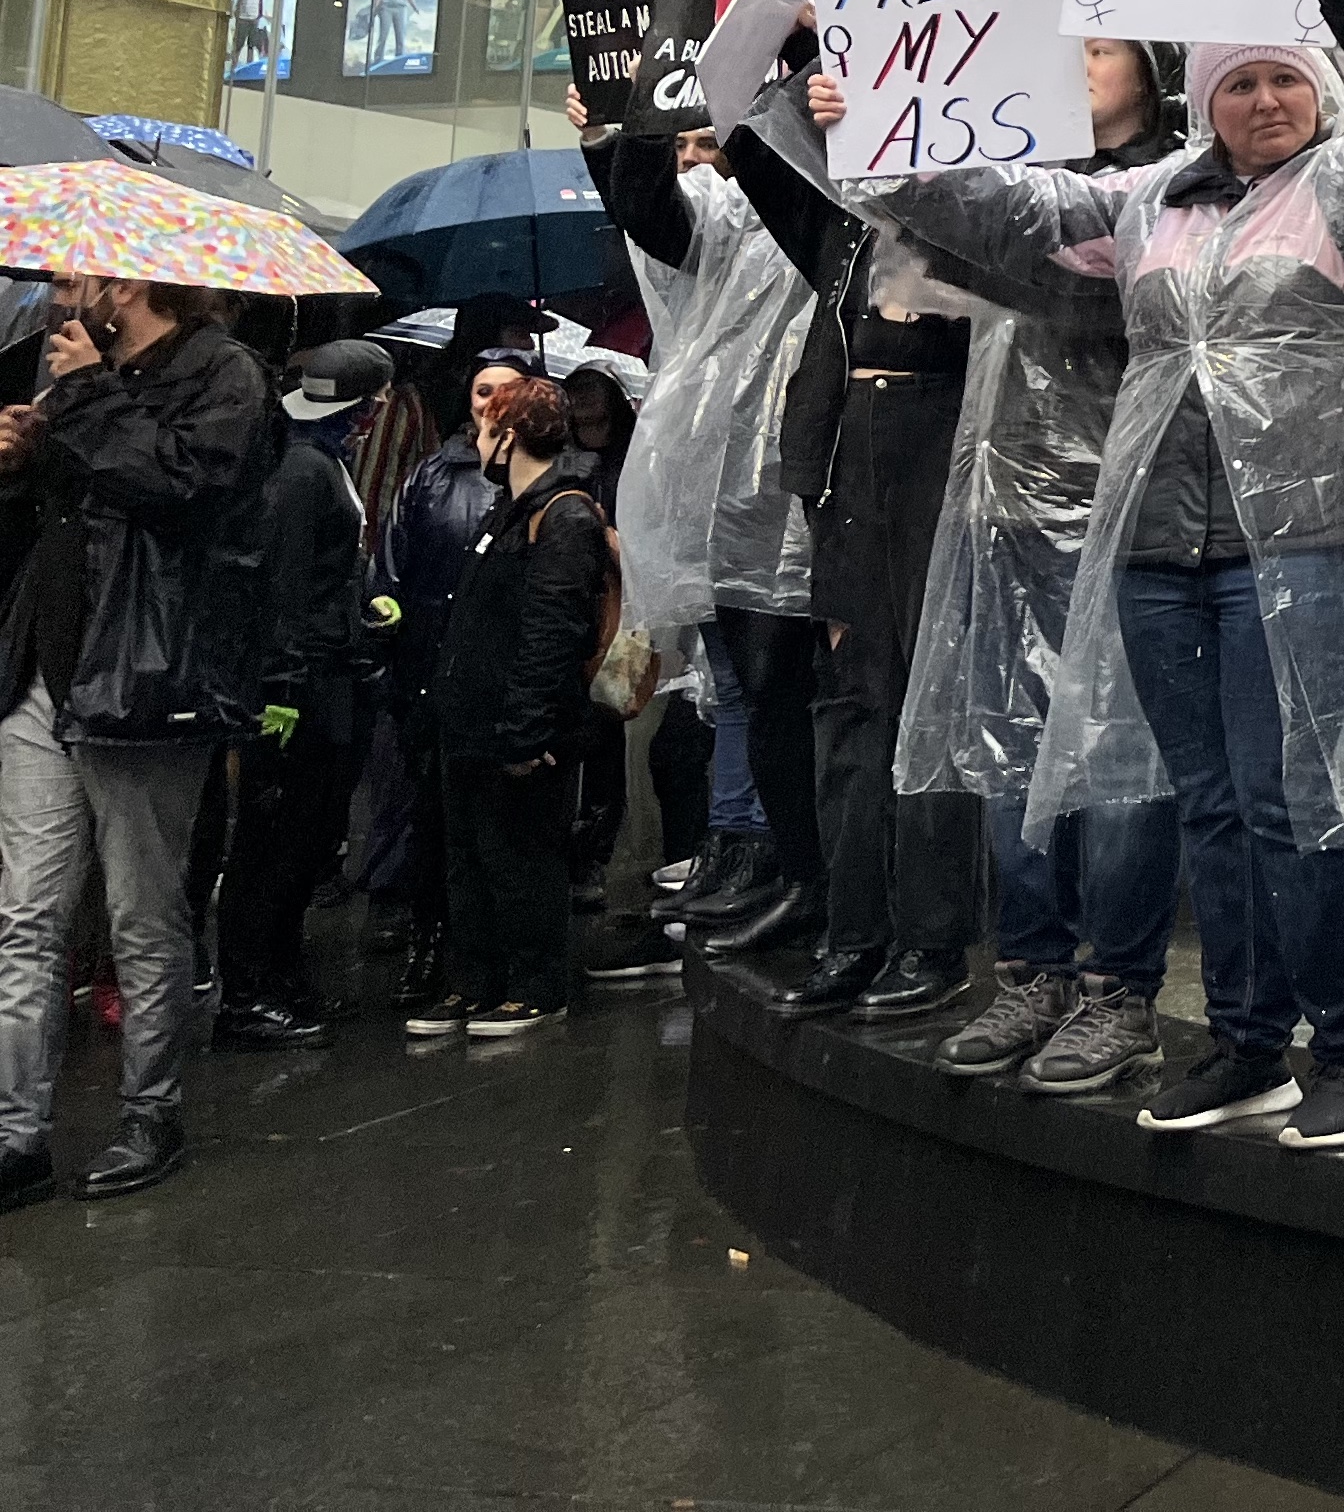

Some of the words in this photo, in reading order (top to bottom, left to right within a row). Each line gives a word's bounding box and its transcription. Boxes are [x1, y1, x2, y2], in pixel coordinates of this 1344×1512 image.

[568, 9, 616, 39] STEAL
[620, 6, 631, 29] A
[654, 37, 675, 62] A
[872, 9, 999, 91] MY
[867, 92, 1037, 172] ASS
